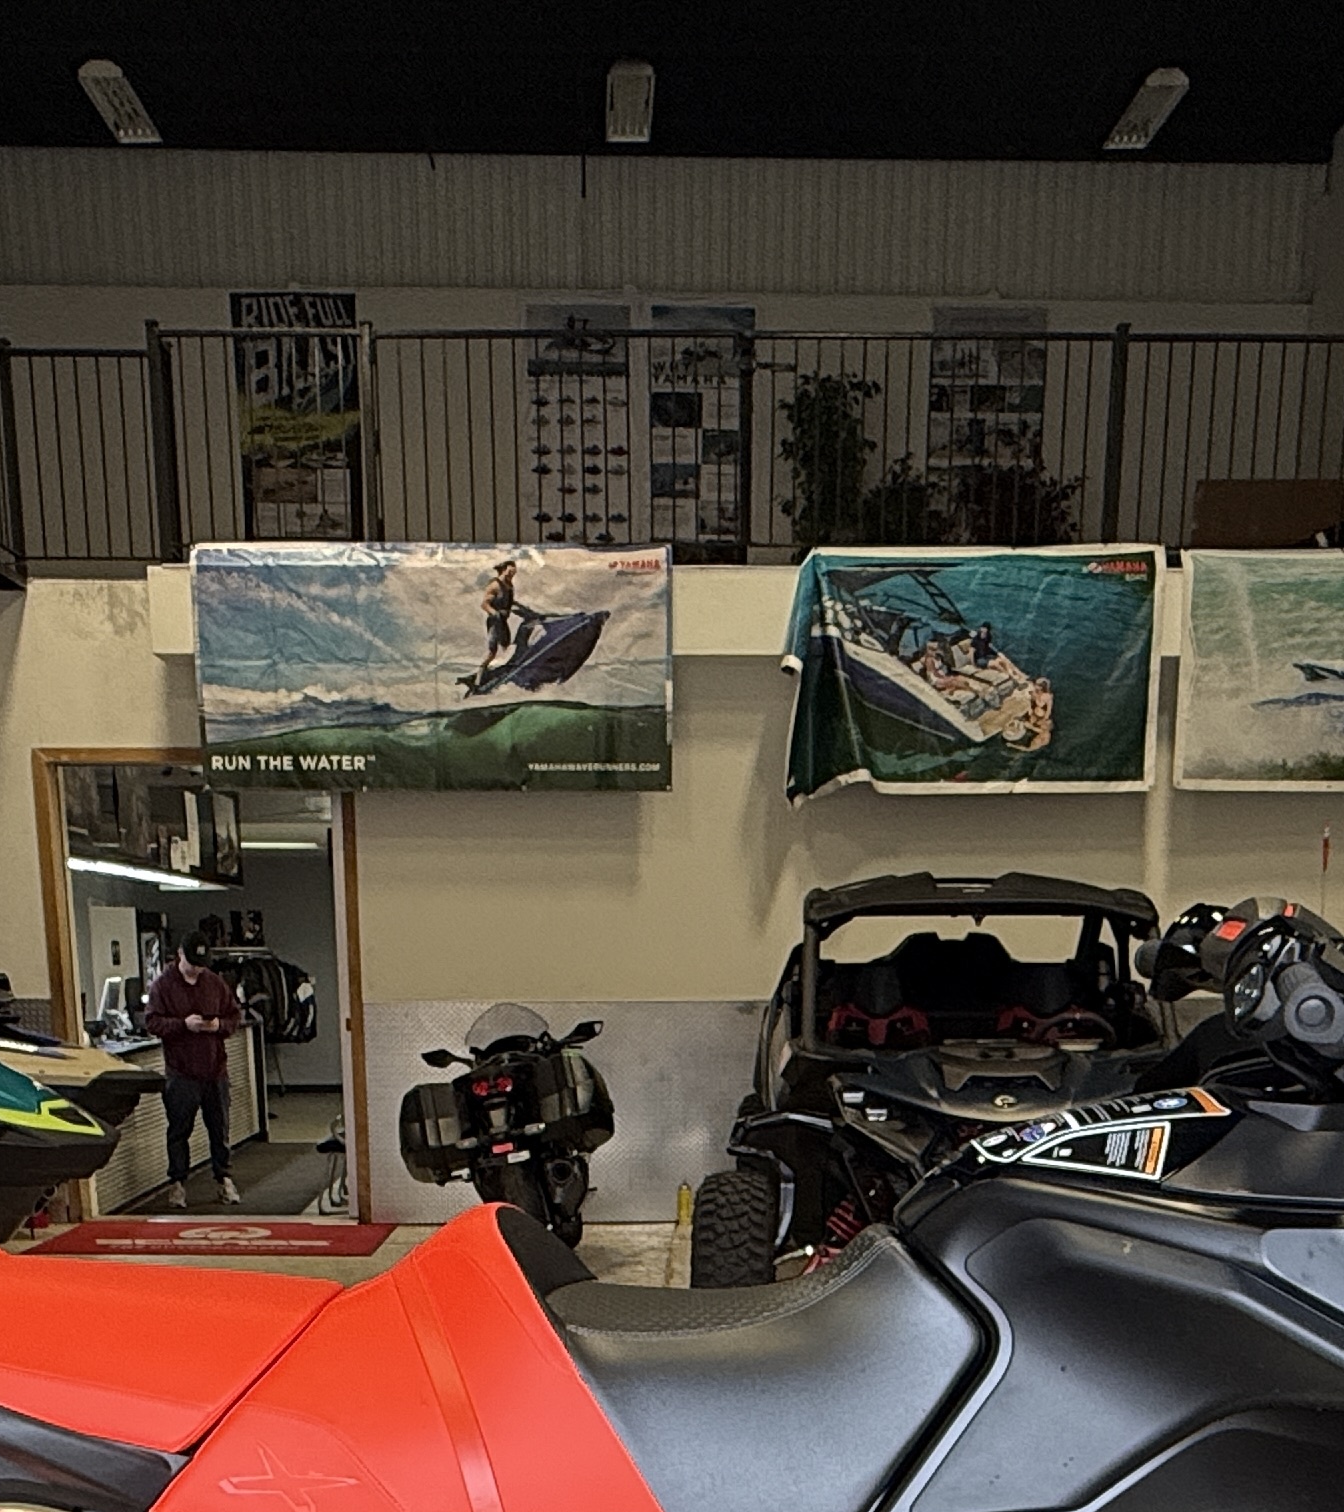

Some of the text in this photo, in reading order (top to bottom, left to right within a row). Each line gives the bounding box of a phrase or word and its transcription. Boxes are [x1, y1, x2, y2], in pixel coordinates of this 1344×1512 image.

[653, 374, 728, 385] YAMAHA
[211, 755, 252, 771] RUN
[257, 755, 294, 771] THE
